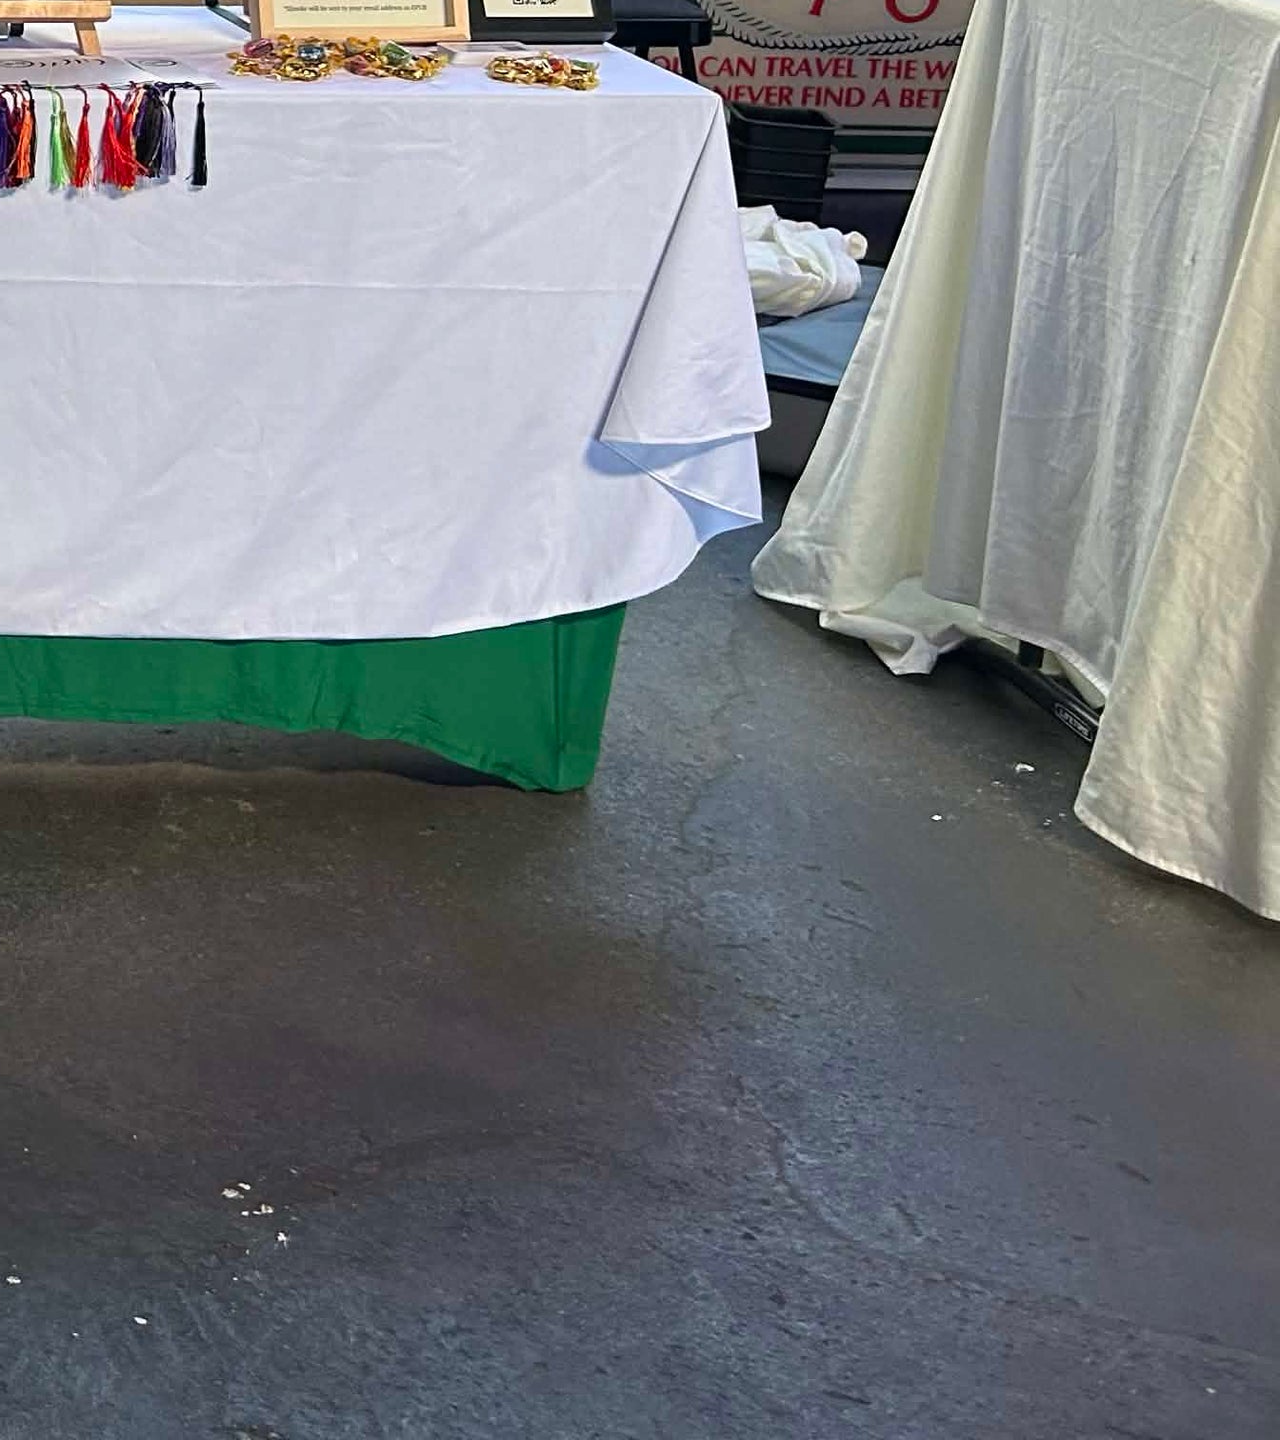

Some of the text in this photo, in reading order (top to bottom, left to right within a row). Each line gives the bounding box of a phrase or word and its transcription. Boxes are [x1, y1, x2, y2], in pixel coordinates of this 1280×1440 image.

[698, 56, 757, 78] CAN
[765, 56, 857, 78] TRAVEL
[864, 58, 919, 79] THE
[713, 85, 793, 107] NEVER
[800, 86, 867, 108] FIND
[872, 87, 890, 108] A
